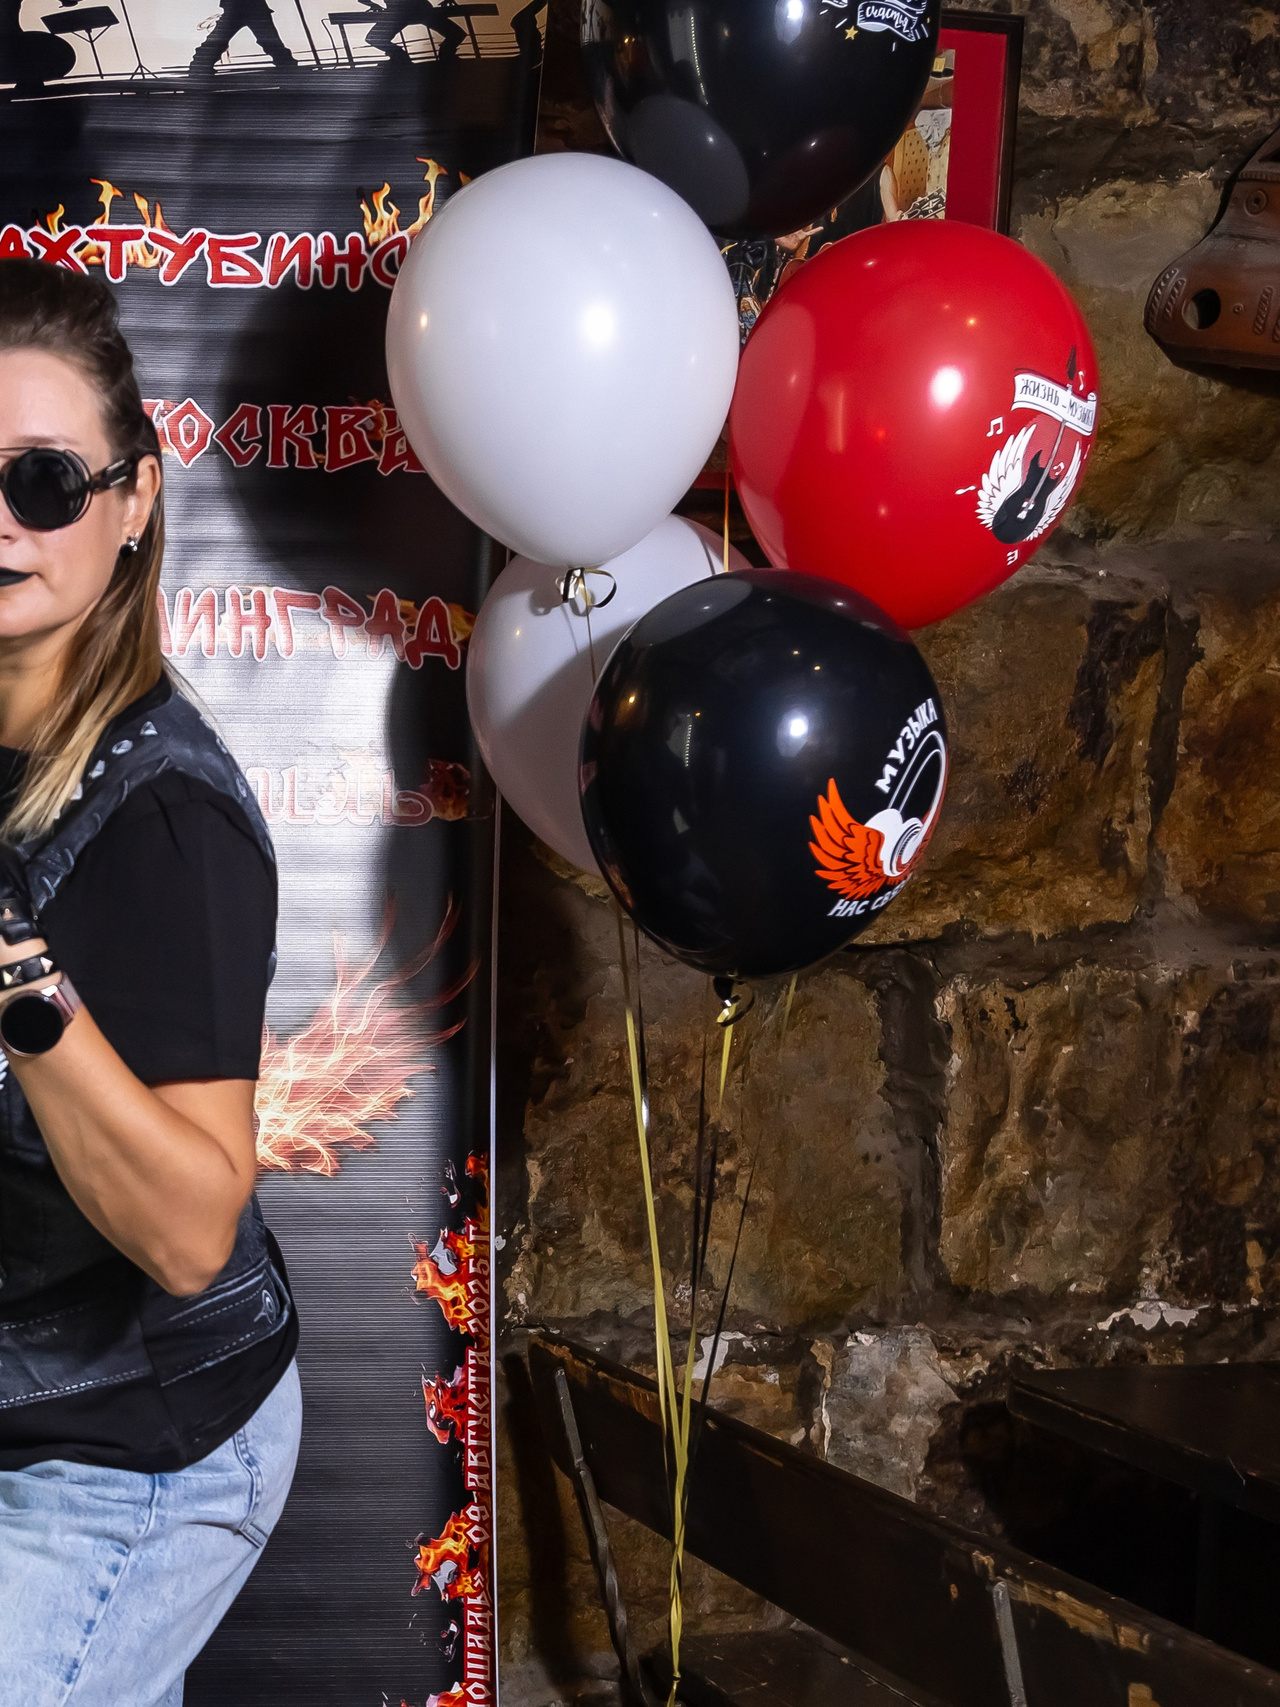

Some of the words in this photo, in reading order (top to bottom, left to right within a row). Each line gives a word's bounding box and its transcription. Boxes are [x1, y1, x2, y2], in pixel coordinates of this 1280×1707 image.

[1020, 378, 1060, 407] ЖИЗНЬ
[875, 698, 938, 794] МУЗЫКА
[827, 898, 869, 918] НАС
[468, 1258, 491, 1336] 2025
